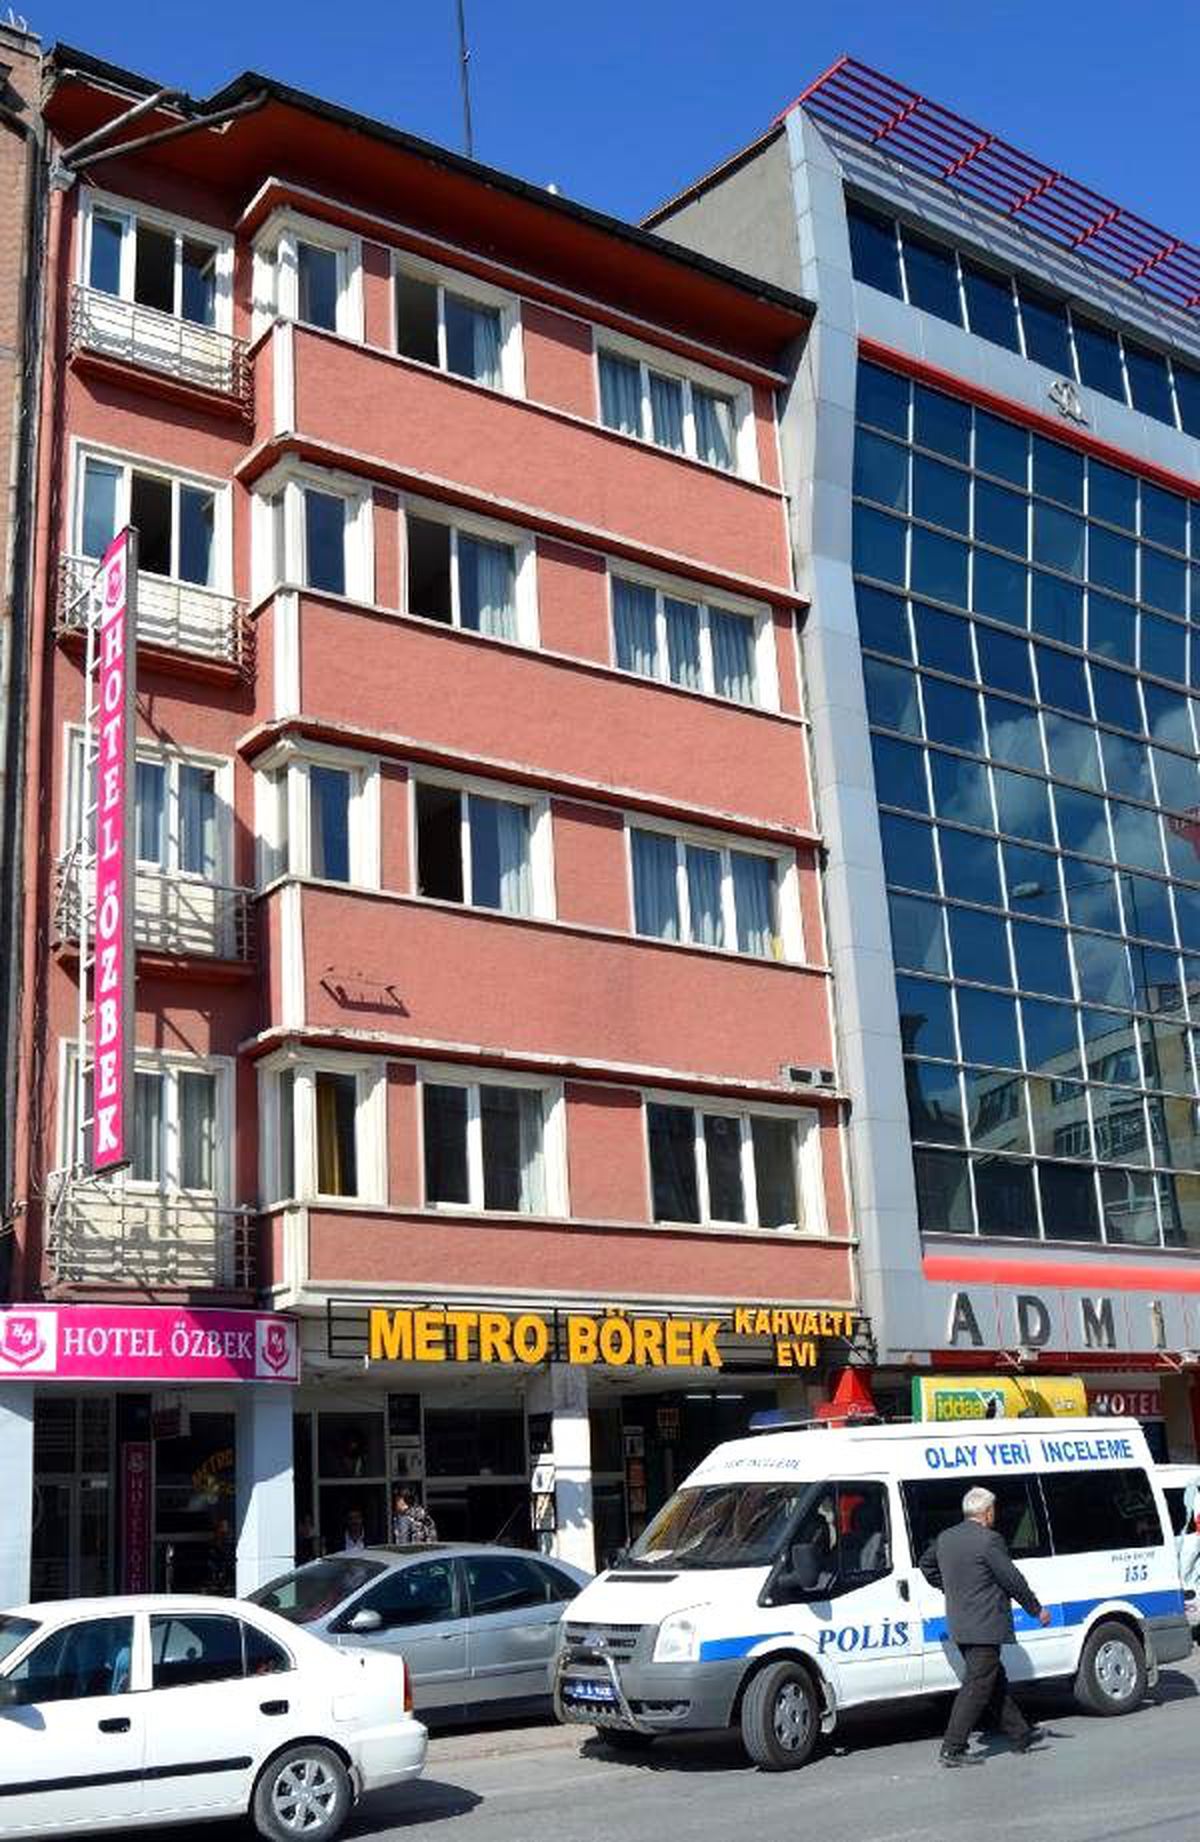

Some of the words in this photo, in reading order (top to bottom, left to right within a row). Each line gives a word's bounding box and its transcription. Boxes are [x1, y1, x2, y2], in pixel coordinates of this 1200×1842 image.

[101, 613, 123, 858] HOTEL
[97, 879, 120, 1154] ÖZBEK
[63, 1327, 162, 1357] HOTEL
[171, 1321, 253, 1360] ÖZBEK
[370, 1308, 548, 1363] METRO
[567, 1304, 723, 1367] BÖREK
[735, 1306, 853, 1337] KAHVALTI
[925, 1445, 977, 1470] OLAY
[985, 1438, 1031, 1466] YERİ
[1041, 1437, 1134, 1463] İNCELEME
[1124, 1564, 1148, 1583] 155
[817, 1617, 909, 1654] POLİS
